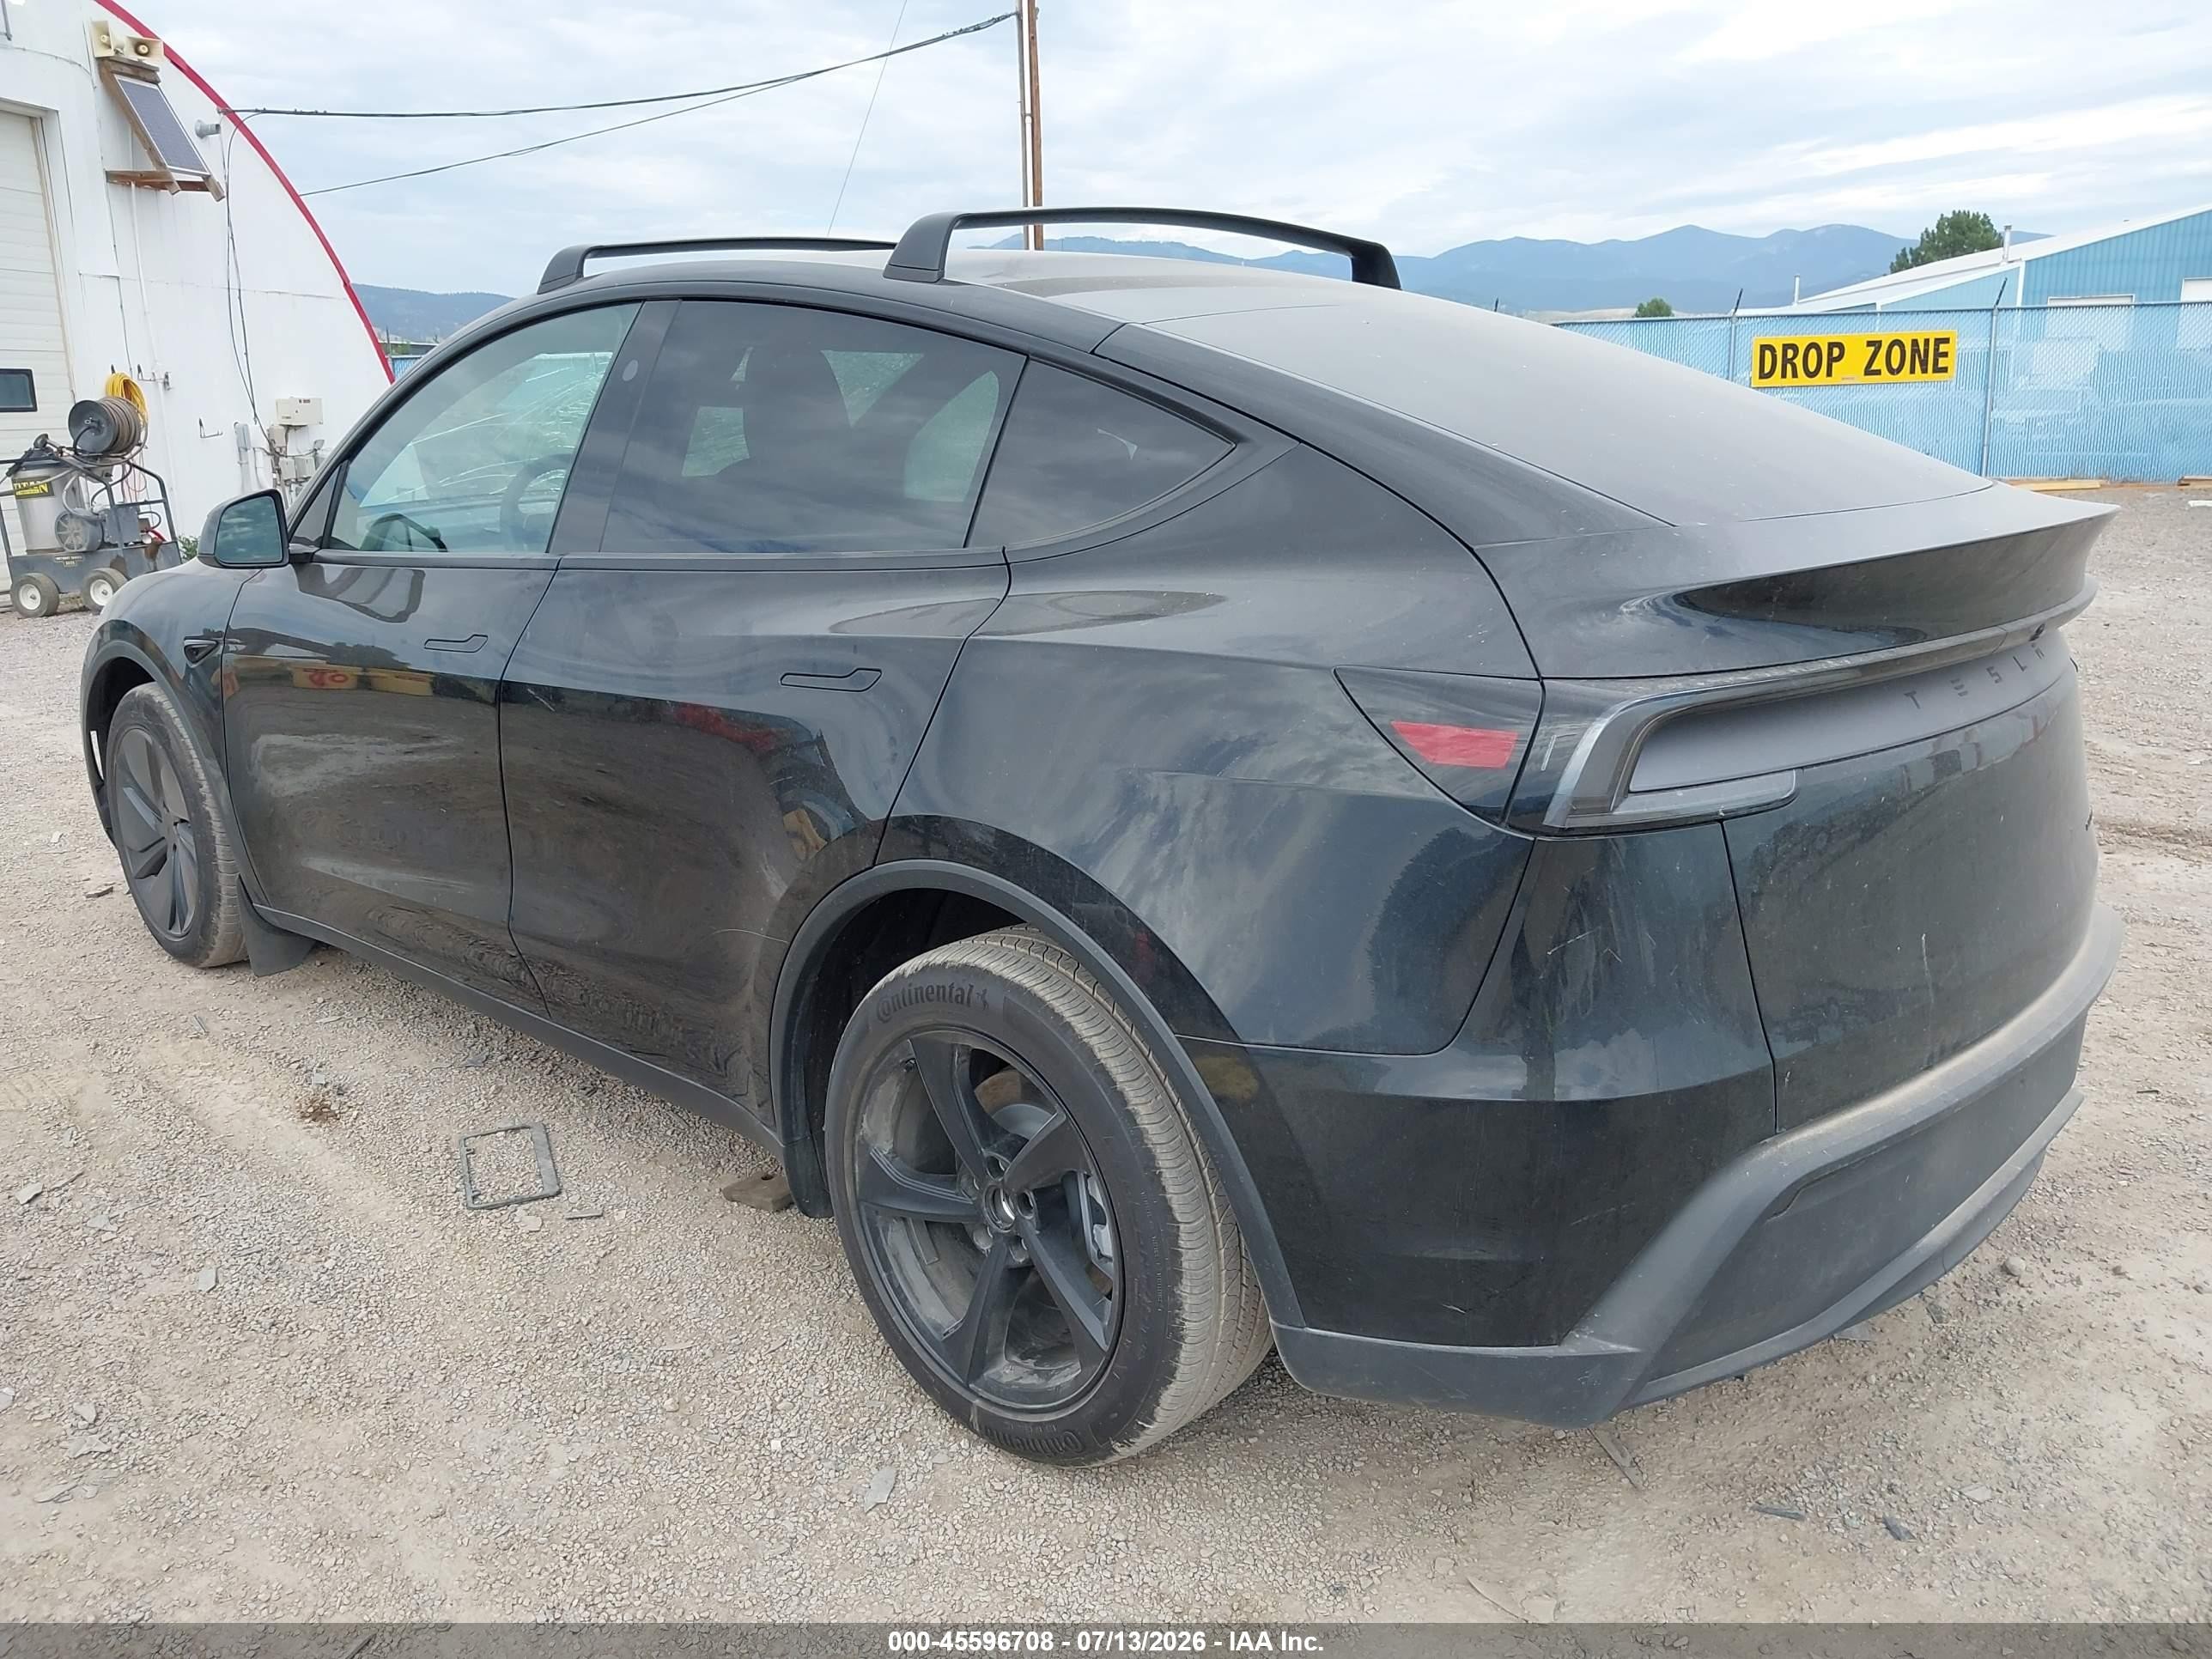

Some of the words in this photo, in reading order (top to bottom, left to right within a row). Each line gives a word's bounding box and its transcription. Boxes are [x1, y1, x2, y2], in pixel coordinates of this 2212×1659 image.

[1758, 341, 1846, 380] DROP
[1863, 337, 1951, 377] ZONE
[876, 981, 975, 1024] Continental
